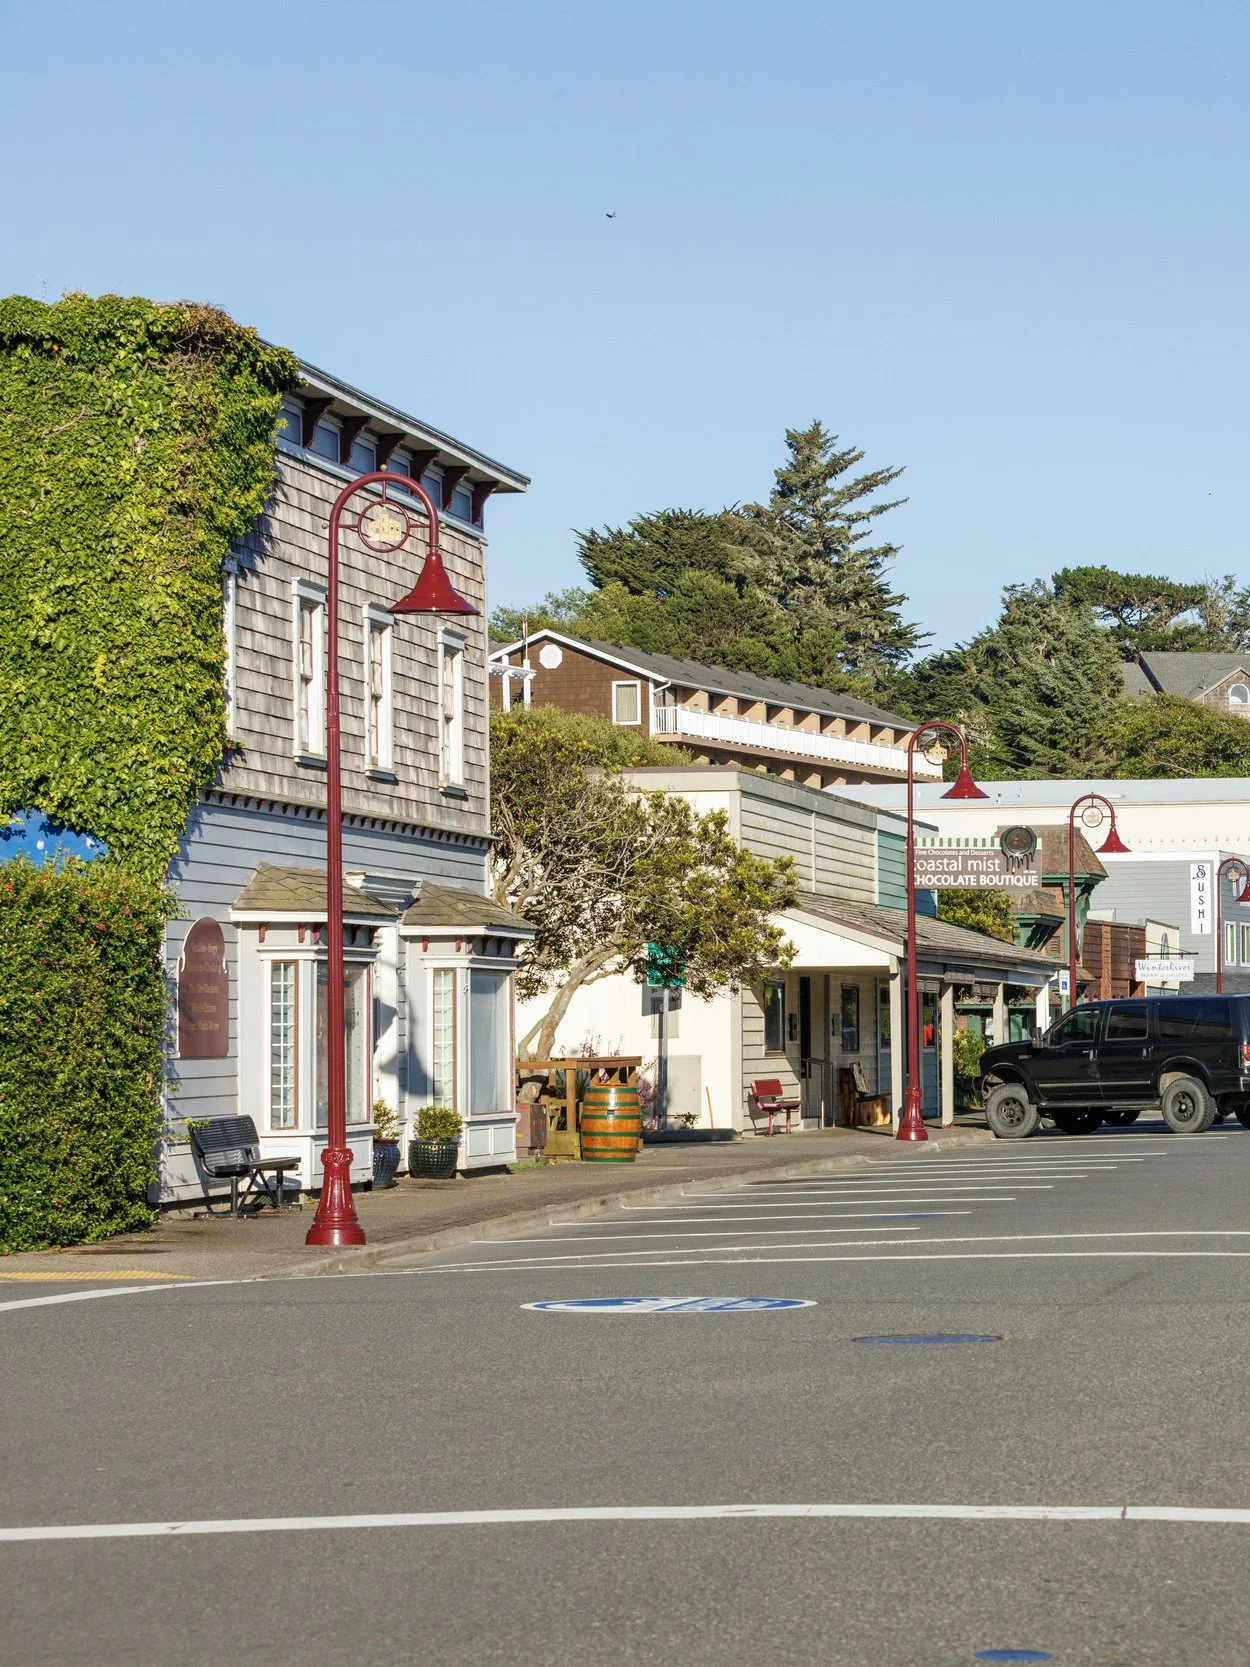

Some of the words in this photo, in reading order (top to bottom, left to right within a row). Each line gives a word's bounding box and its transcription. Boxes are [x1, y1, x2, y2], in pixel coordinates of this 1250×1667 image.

[914, 856, 962, 872] oastal
[967, 857, 1000, 872] mist
[979, 875, 1038, 887] BOUTIQUE
[1192, 864, 1206, 933] SUSHI
